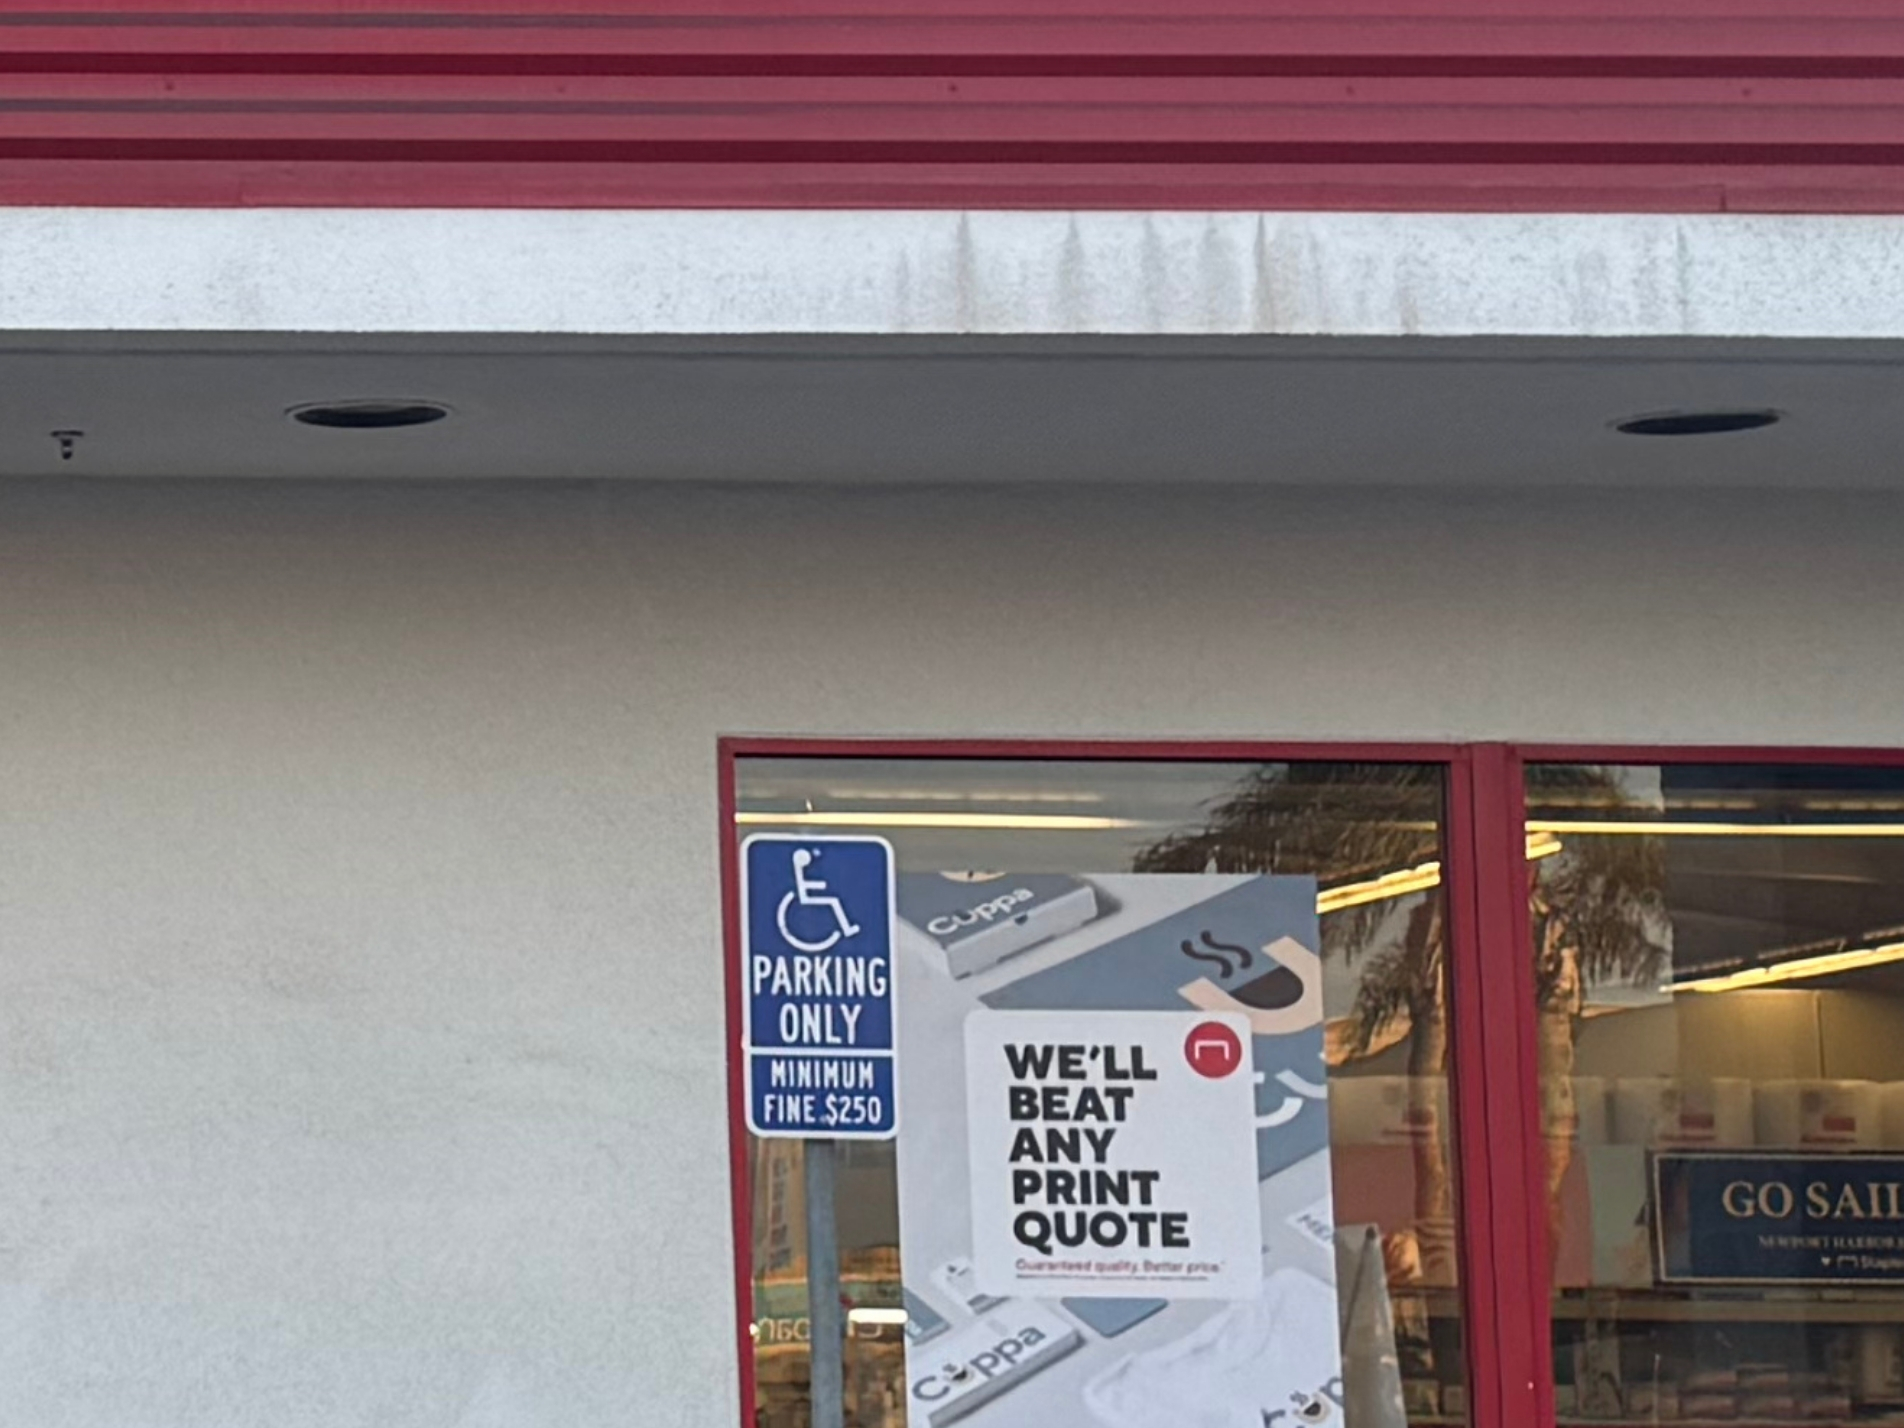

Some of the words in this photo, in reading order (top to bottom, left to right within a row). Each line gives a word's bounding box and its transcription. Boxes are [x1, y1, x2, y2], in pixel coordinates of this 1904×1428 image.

[927, 888, 1034, 936] Cuppa
[752, 954, 887, 998] PARKING
[779, 1003, 863, 1045] ONLY
[771, 1059, 875, 1090] MINIMUM
[1004, 1044, 1158, 1080] WE'LL
[764, 1094, 817, 1124] FINE
[824, 1093, 882, 1127] $250
[1009, 1086, 1135, 1122] BEAT
[1008, 1127, 1117, 1164] ANY
[1013, 1169, 1161, 1206] PRINT
[1722, 1180, 1794, 1218] GO
[1013, 1210, 1191, 1256] QUOTE
[912, 1326, 1046, 1403] Cuppa
